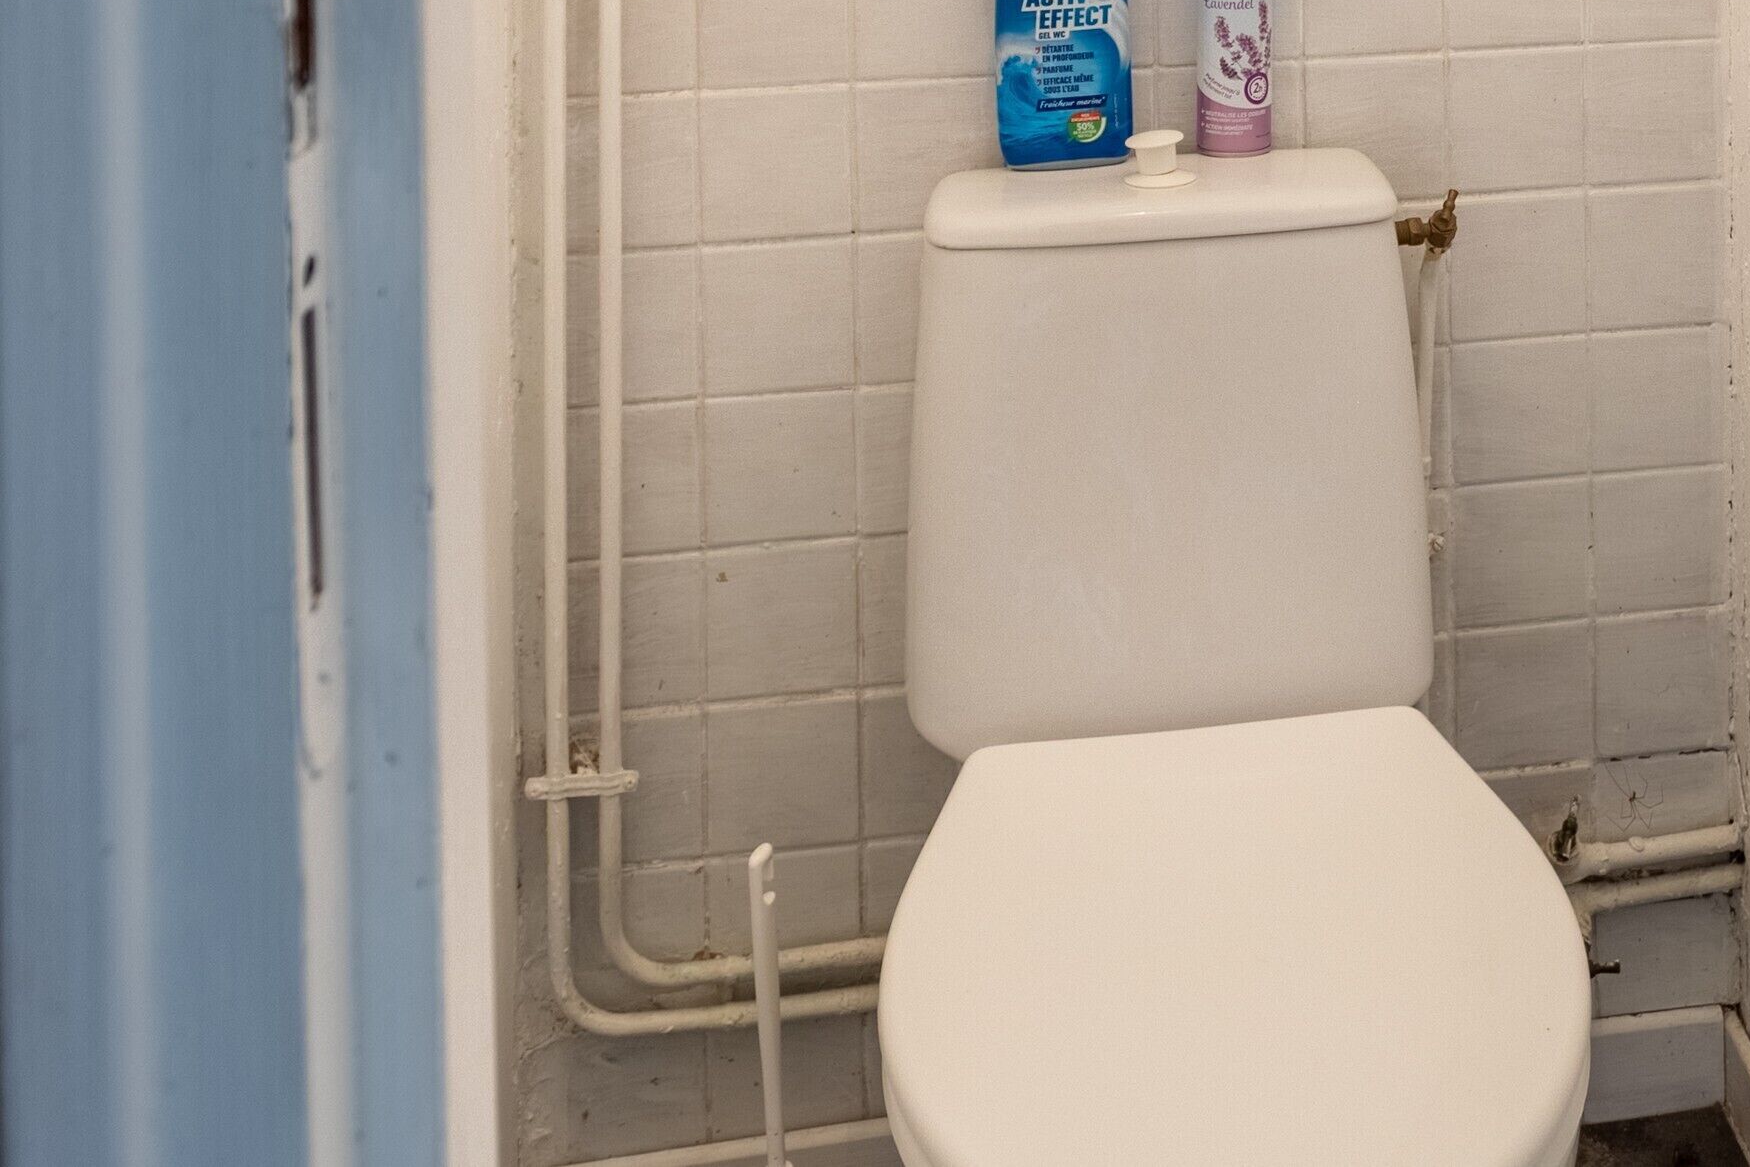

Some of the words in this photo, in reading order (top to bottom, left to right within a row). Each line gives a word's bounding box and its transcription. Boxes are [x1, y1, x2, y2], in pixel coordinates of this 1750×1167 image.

[1039, 5, 1112, 29] EFFECT
[1038, 31, 1051, 40] GEL
[1053, 30, 1066, 38] WC
[1043, 76, 1072, 86] EFFICACE
[1073, 73, 1094, 83] MÊME
[1043, 86, 1061, 94] SOUS
[1062, 84, 1080, 93] L'EAU
[1076, 121, 1095, 131] 50%
